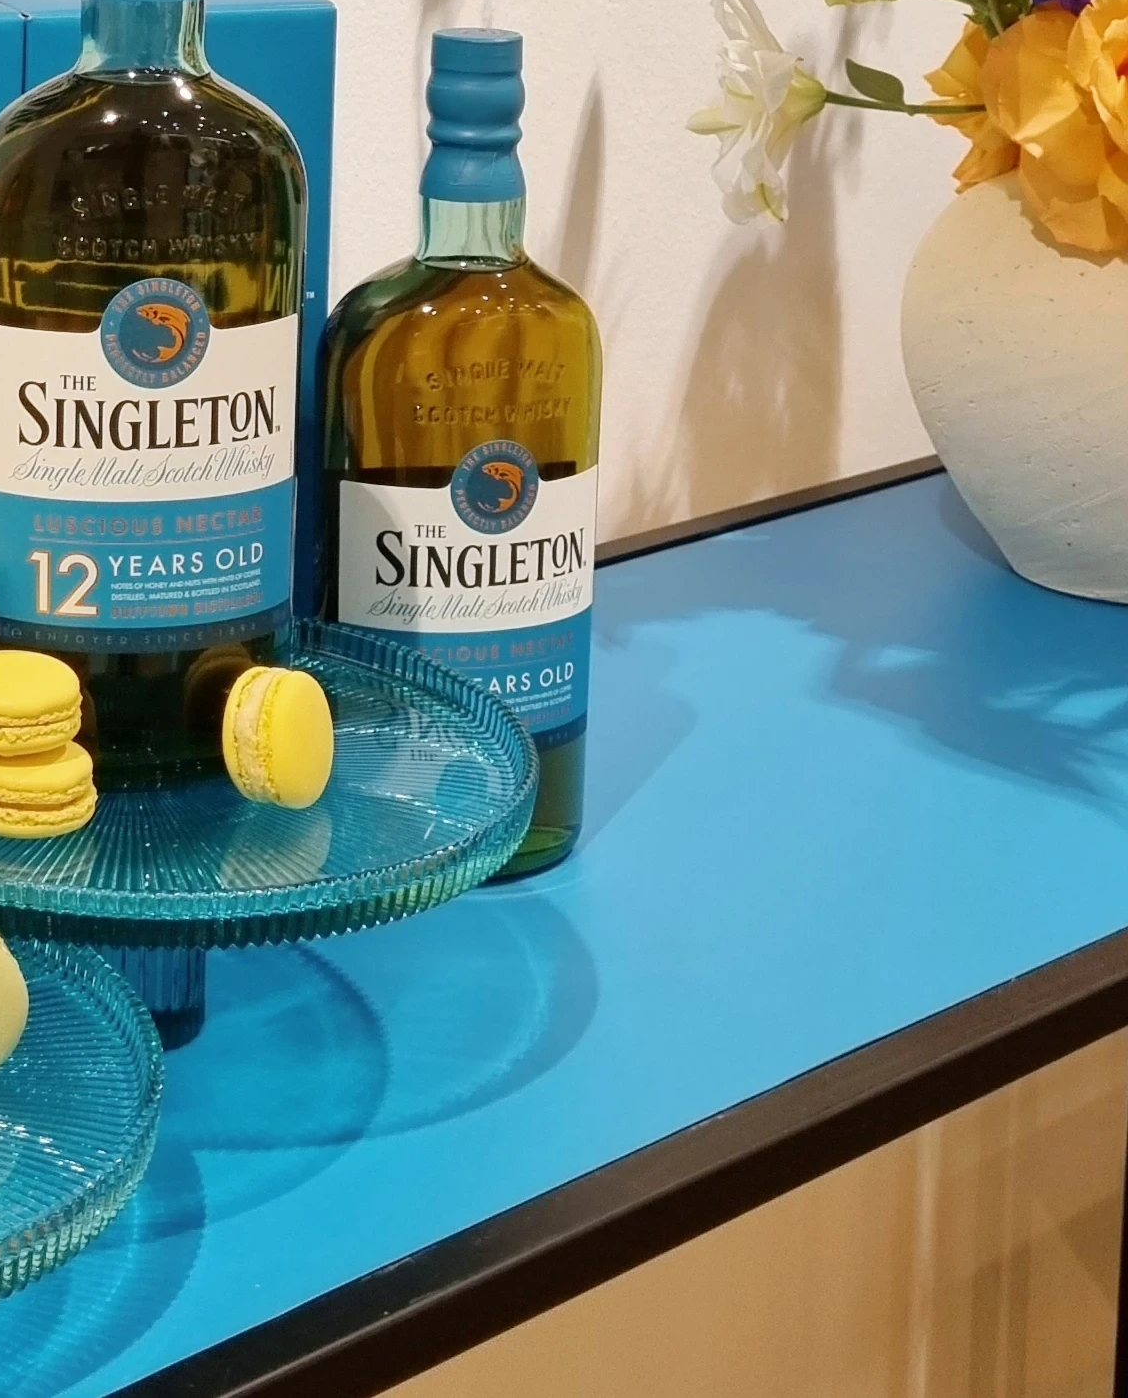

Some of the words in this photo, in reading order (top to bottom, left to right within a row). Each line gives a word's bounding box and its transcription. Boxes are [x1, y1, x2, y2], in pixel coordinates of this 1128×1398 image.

[60, 374, 97, 392] THE
[18, 381, 277, 451] SINGLETON
[9, 449, 85, 491] Single
[82, 456, 144, 487] Malt
[138, 453, 213, 487] Scotch
[211, 444, 276, 481] Whisky
[33, 514, 164, 536] LUSCIOUS
[176, 506, 263, 534] NECTAR
[414, 524, 447, 539] THE
[28, 548, 99, 618] 12
[108, 552, 204, 577] YEARS
[215, 542, 264, 570] OLD
[375, 527, 585, 588] SINGLETON
[366, 588, 437, 624] Single
[433, 594, 485, 621] Malt
[482, 589, 539, 619] Scotch
[538, 578, 583, 611] Whisky
[473, 673, 531, 695] ARS
[539, 662, 574, 687] OLD
